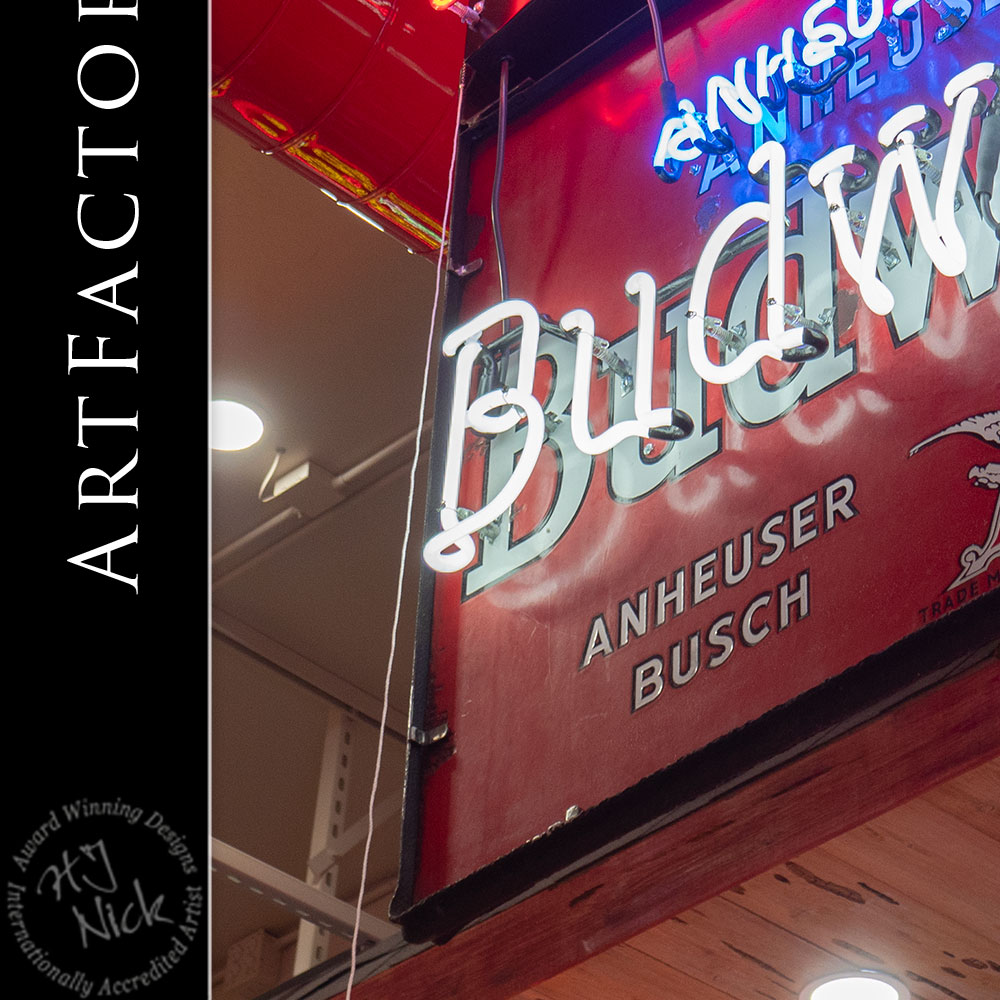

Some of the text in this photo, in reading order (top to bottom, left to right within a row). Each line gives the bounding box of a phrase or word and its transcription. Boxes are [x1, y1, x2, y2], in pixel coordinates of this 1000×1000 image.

[578, 474, 860, 672] ANHEUSER
[630, 568, 811, 714] BUSCH
[918, 580, 980, 624] TRADE
